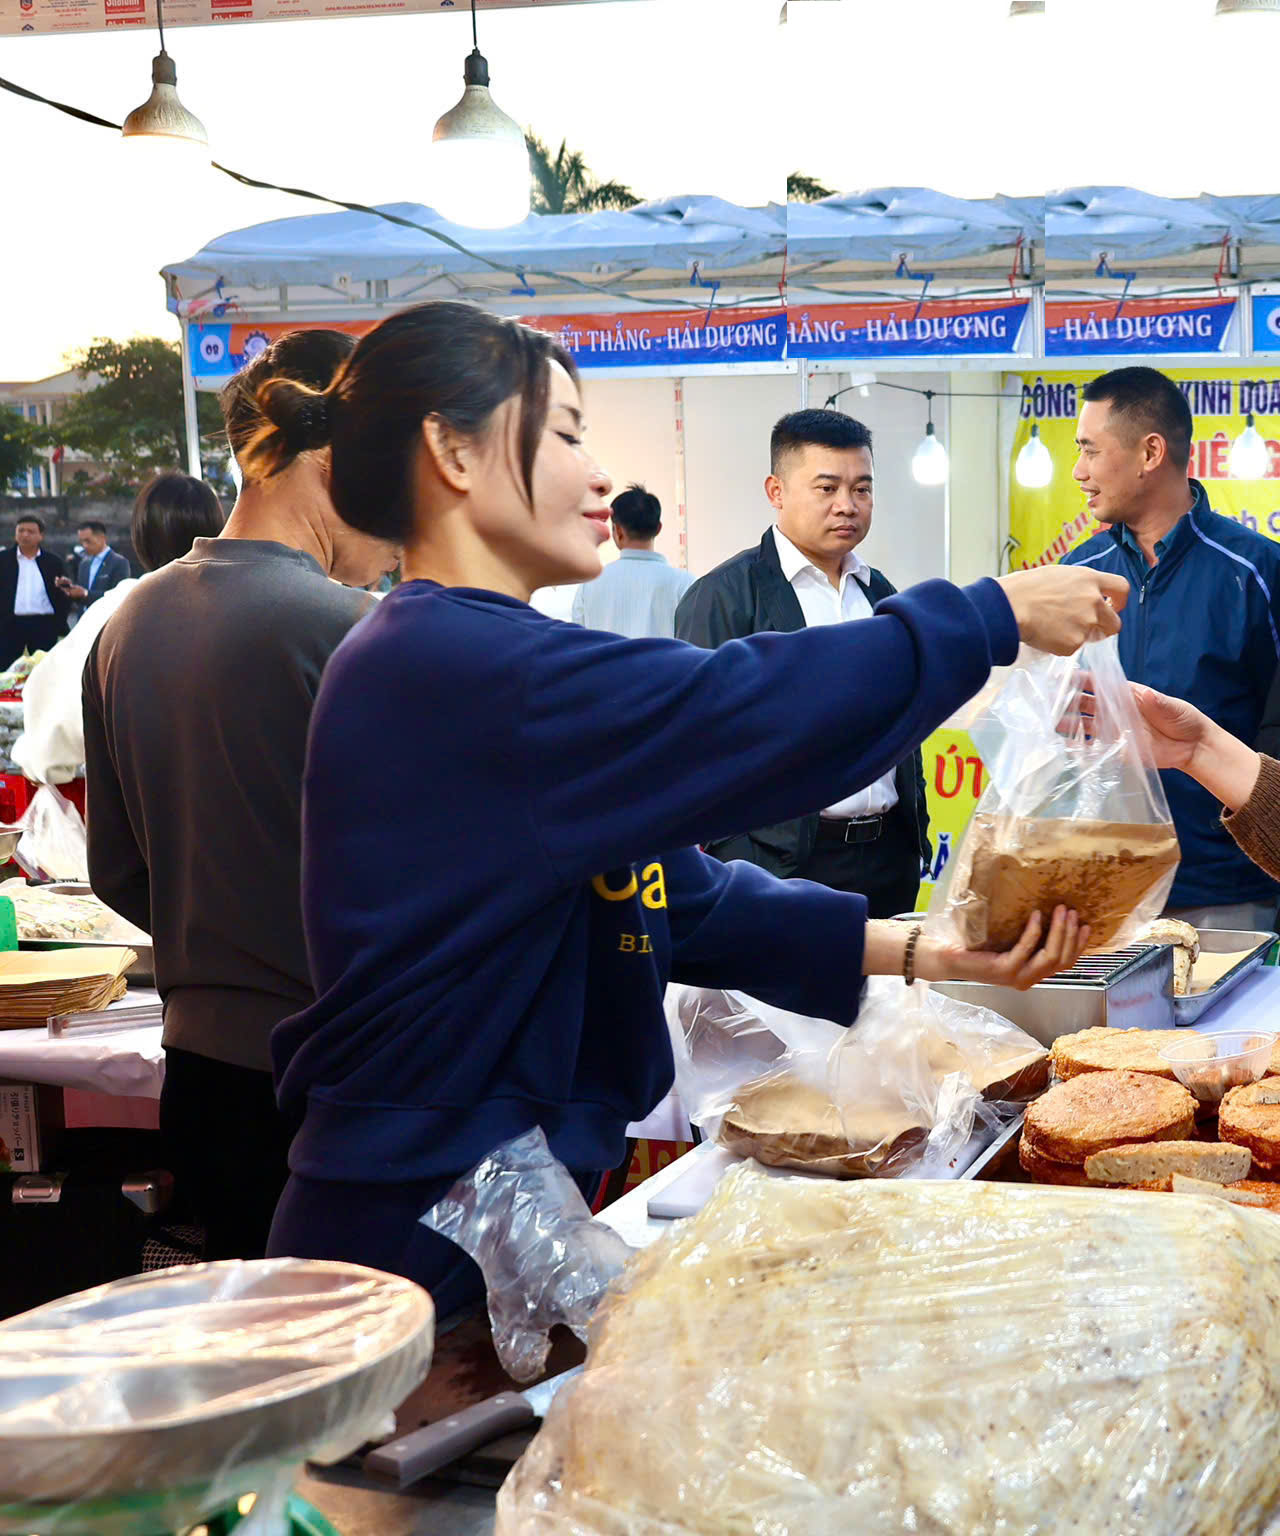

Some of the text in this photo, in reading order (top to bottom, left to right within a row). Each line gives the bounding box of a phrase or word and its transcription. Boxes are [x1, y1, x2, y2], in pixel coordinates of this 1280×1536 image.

[587, 321, 650, 352] THẮNG
[667, 321, 700, 350] HẢI
[705, 322, 777, 347] DƯƠNG
[867, 313, 908, 341] HẢI
[915, 315, 1007, 340] DƯƠNG
[1065, 312, 1108, 341] HẢI
[1116, 314, 1212, 339] DƯƠNG
[1022, 377, 1076, 418] CÔNG
[935, 744, 984, 799] ÚT
